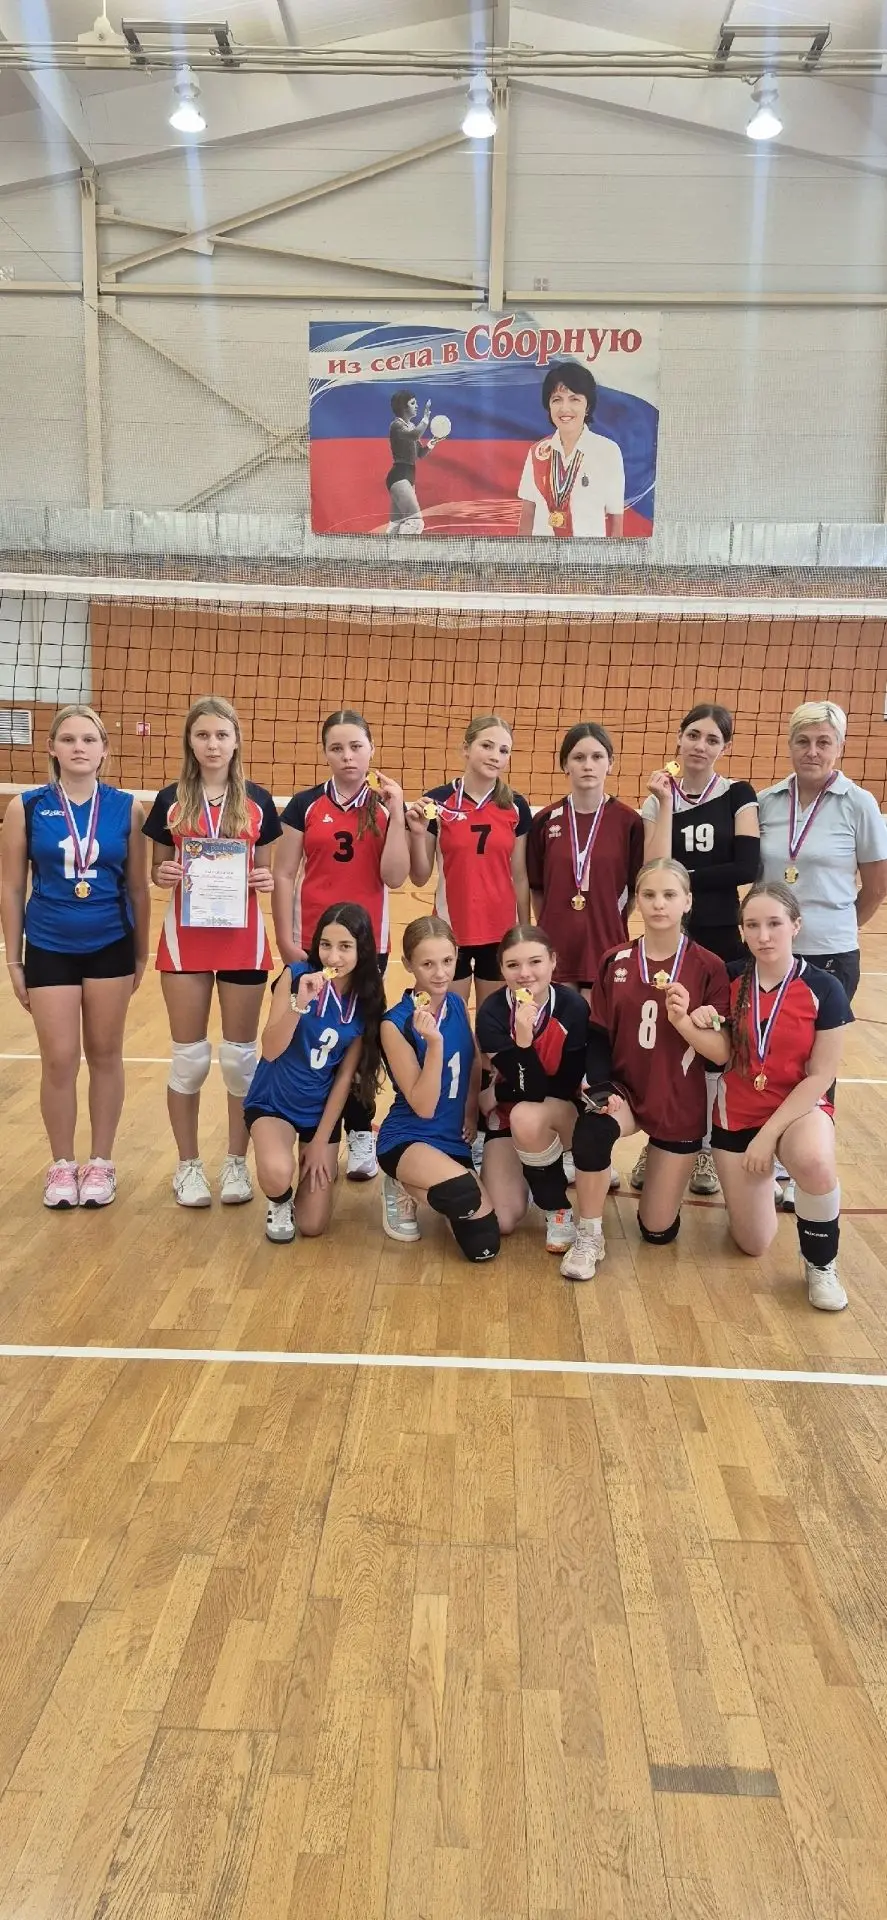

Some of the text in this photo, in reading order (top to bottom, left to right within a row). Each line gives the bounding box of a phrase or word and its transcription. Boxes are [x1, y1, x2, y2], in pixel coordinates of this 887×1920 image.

[370, 347, 432, 372] села
[441, 342, 459, 364] в
[465, 315, 642, 366] Сборную
[58, 835, 99, 879] 12
[333, 830, 354, 863] 3
[470, 824, 492, 855] 7
[680, 823, 715, 852] 19
[638, 999, 659, 1050] 8
[310, 1027, 339, 1070] 3
[447, 1051, 461, 1099] 1
